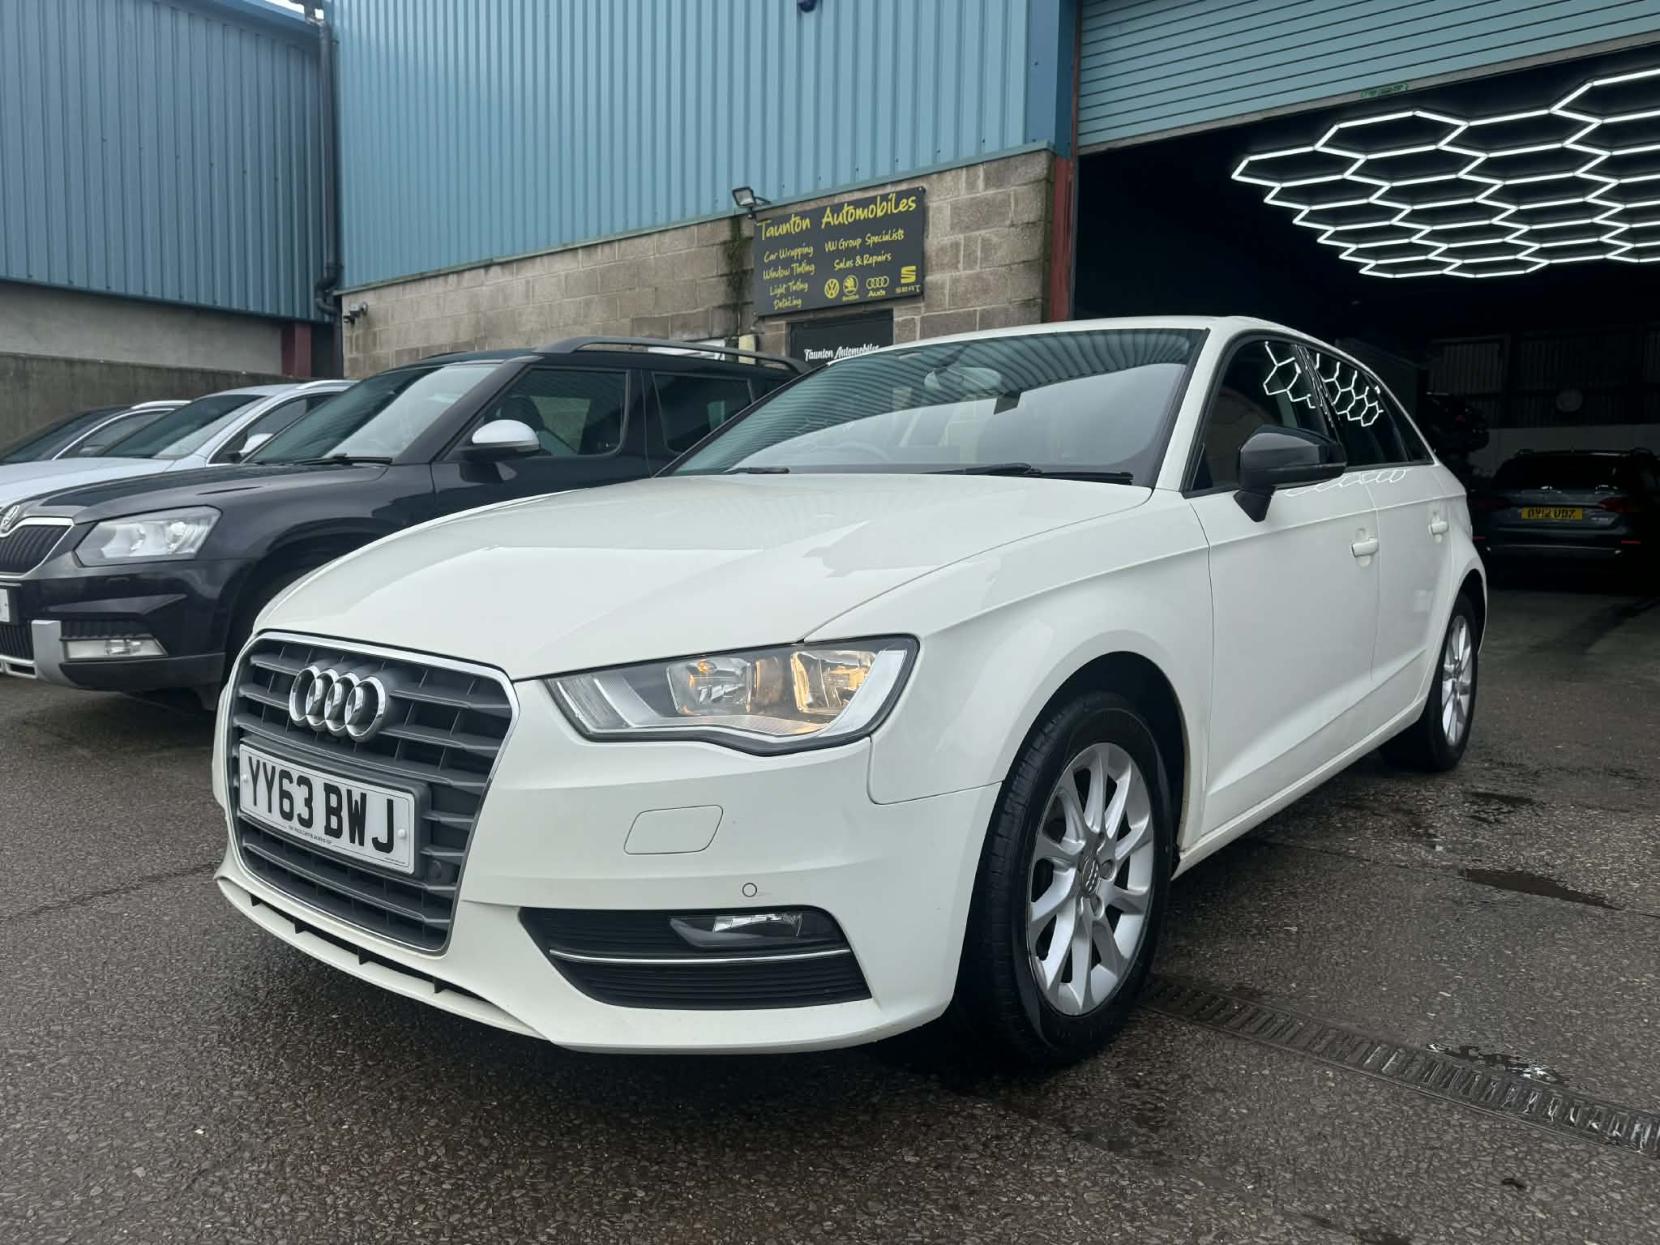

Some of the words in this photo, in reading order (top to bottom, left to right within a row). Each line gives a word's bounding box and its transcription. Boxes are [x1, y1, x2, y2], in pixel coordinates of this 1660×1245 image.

[757, 214, 811, 240] Taunton
[822, 193, 916, 229] Automobiles
[839, 238, 862, 250] Group
[865, 228, 904, 247] Specialists
[764, 251, 778, 263] Car
[779, 246, 814, 260] Wrapping
[834, 257, 854, 271] Sales
[855, 256, 862, 267] &
[863, 251, 892, 267] Repairs
[763, 266, 790, 280] Window
[804, 348, 834, 362] Taunton
[248, 756, 314, 829] YY63
[323, 782, 395, 854] BWJ
